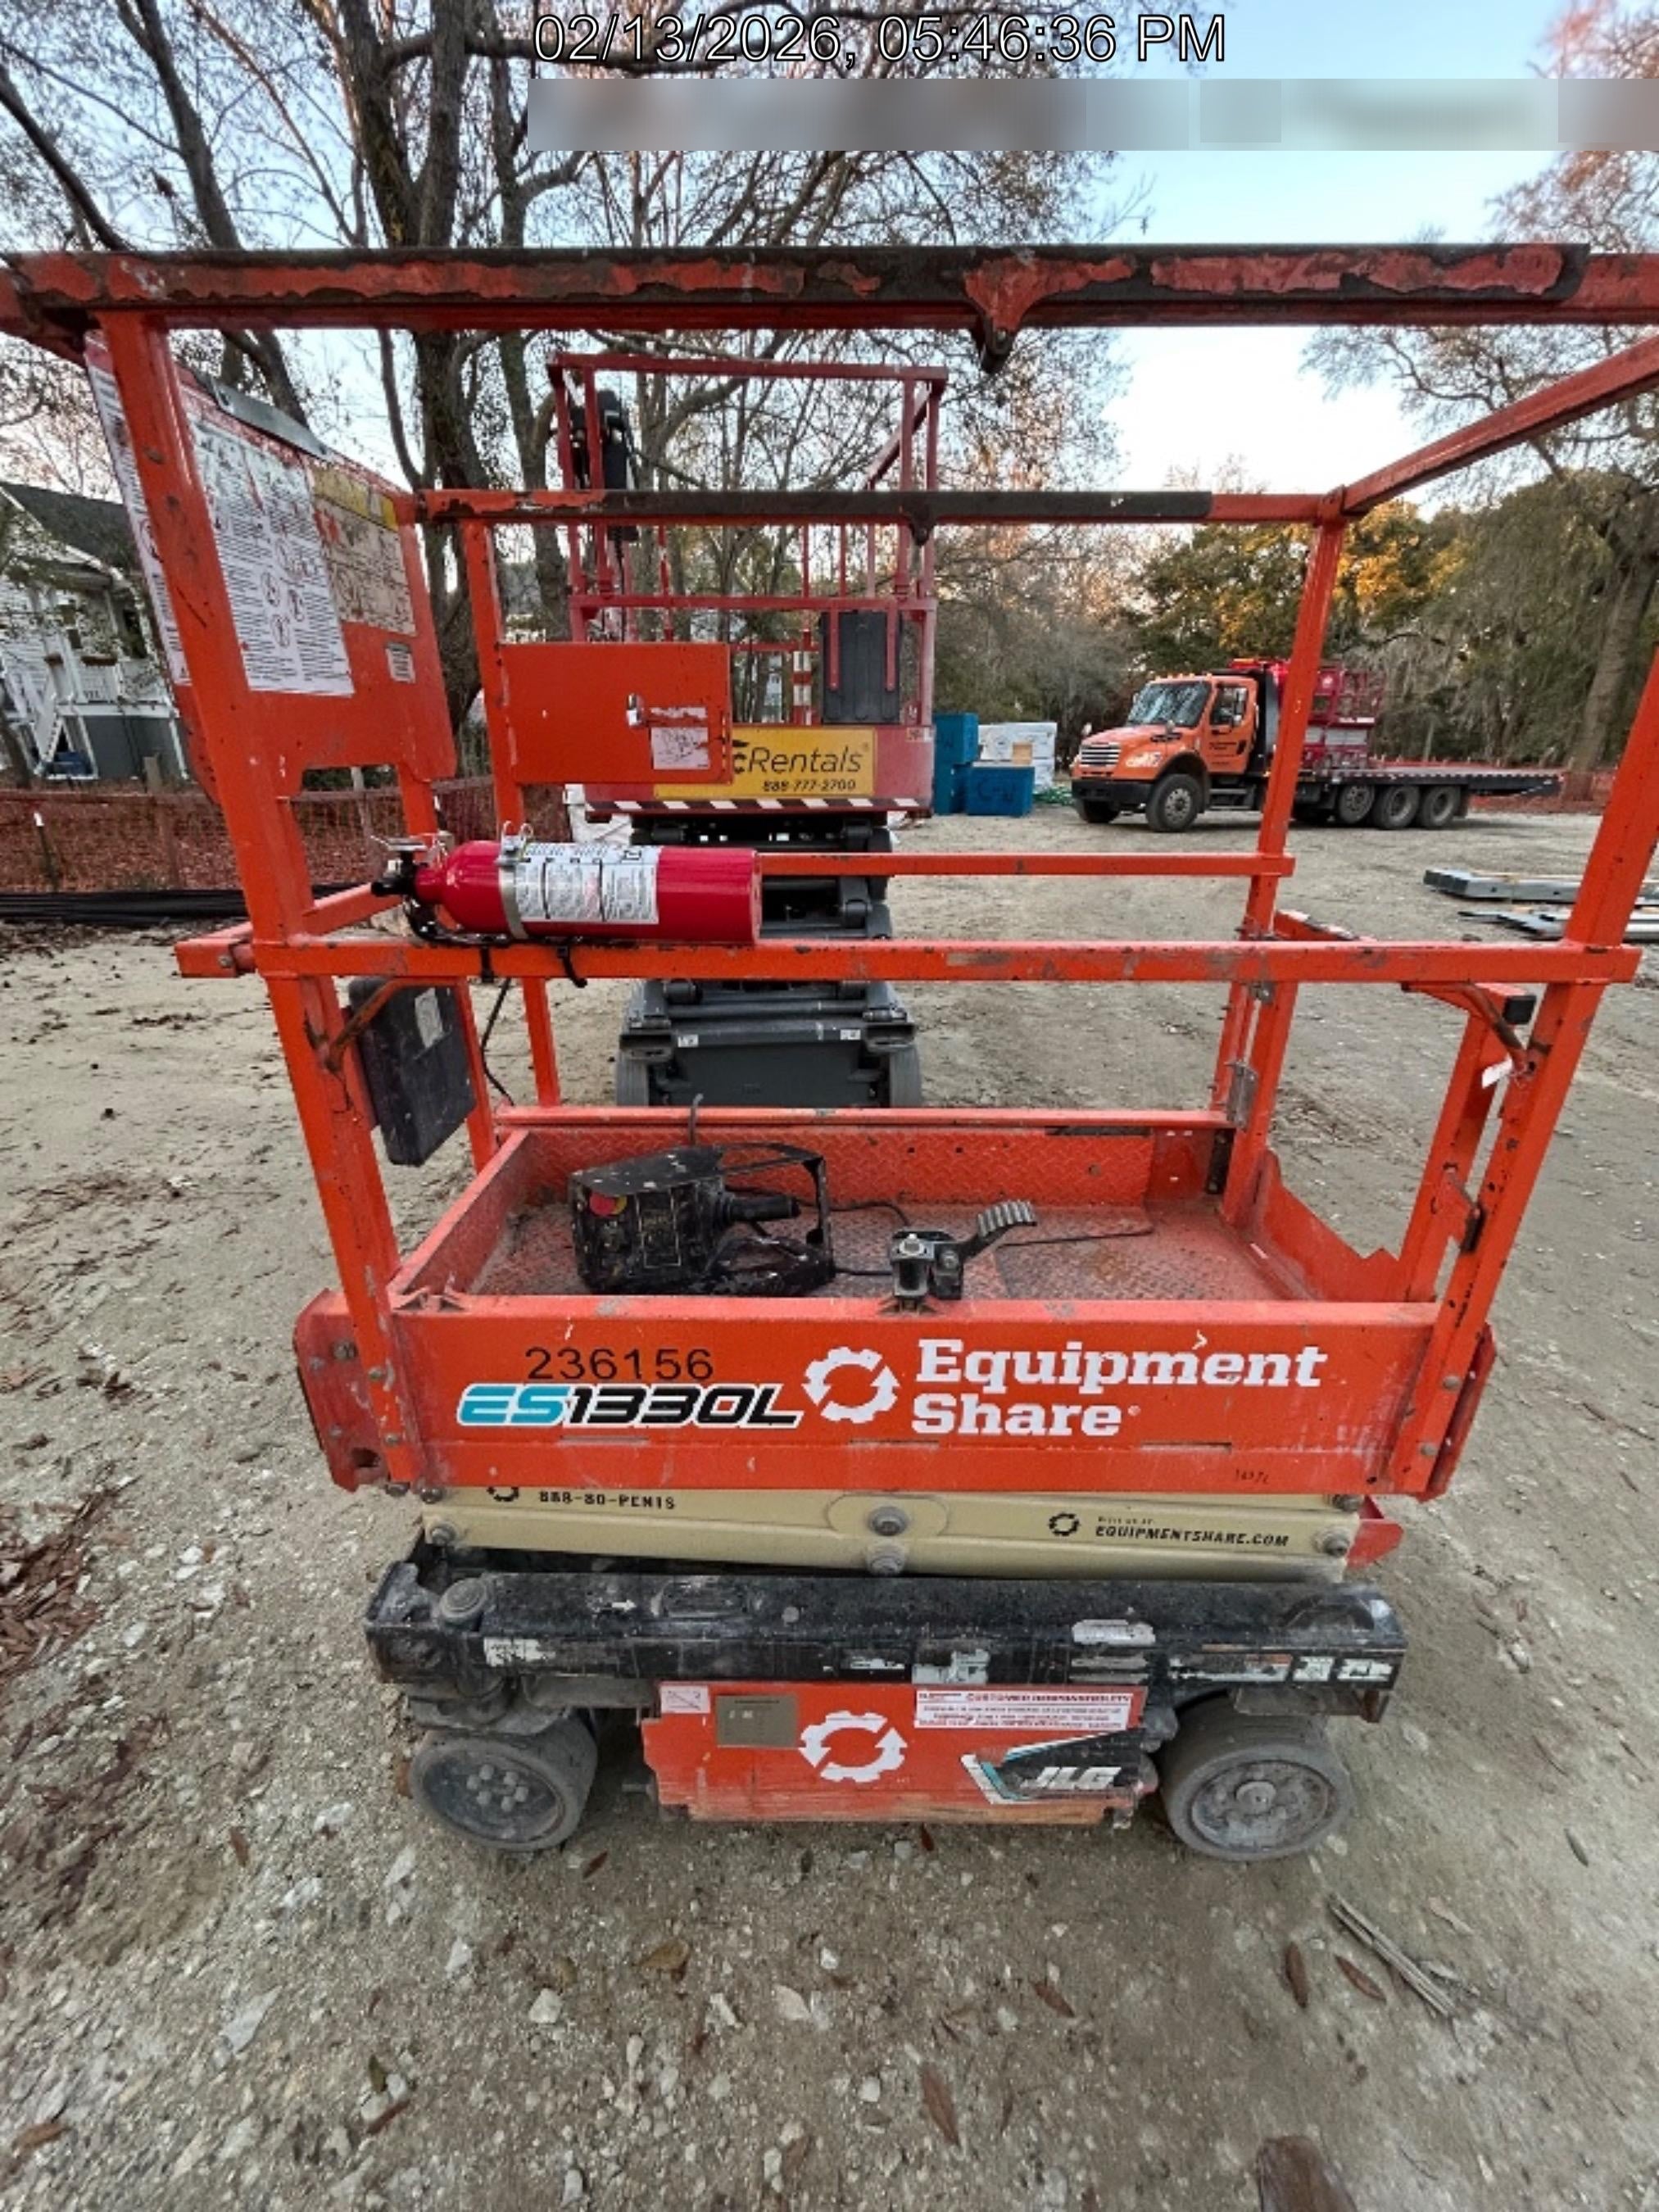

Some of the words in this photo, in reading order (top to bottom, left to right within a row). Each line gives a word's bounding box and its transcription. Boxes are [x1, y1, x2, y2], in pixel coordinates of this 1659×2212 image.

[524, 1346, 714, 1381] 236156
[914, 1337, 1329, 1394] Equipment
[456, 1382, 805, 1430] ES1330L
